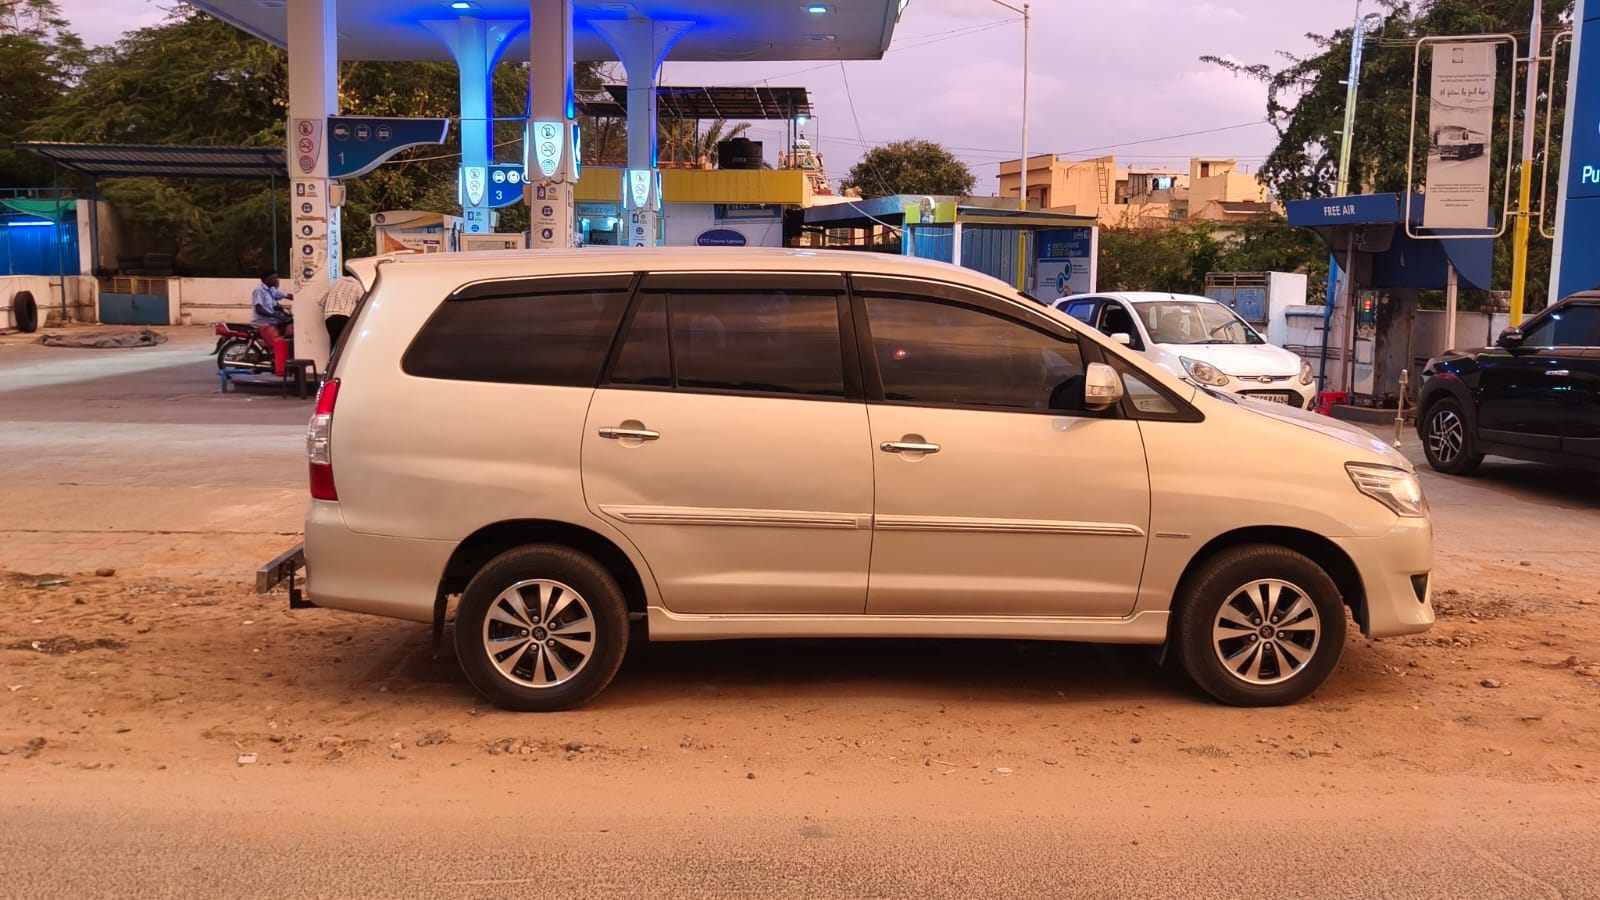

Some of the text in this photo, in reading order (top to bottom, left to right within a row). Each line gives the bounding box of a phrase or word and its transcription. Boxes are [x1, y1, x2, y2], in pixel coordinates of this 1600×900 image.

[338, 151, 345, 166] 1
[495, 190, 503, 200] 3
[1323, 204, 1356, 216] FREE AIR
